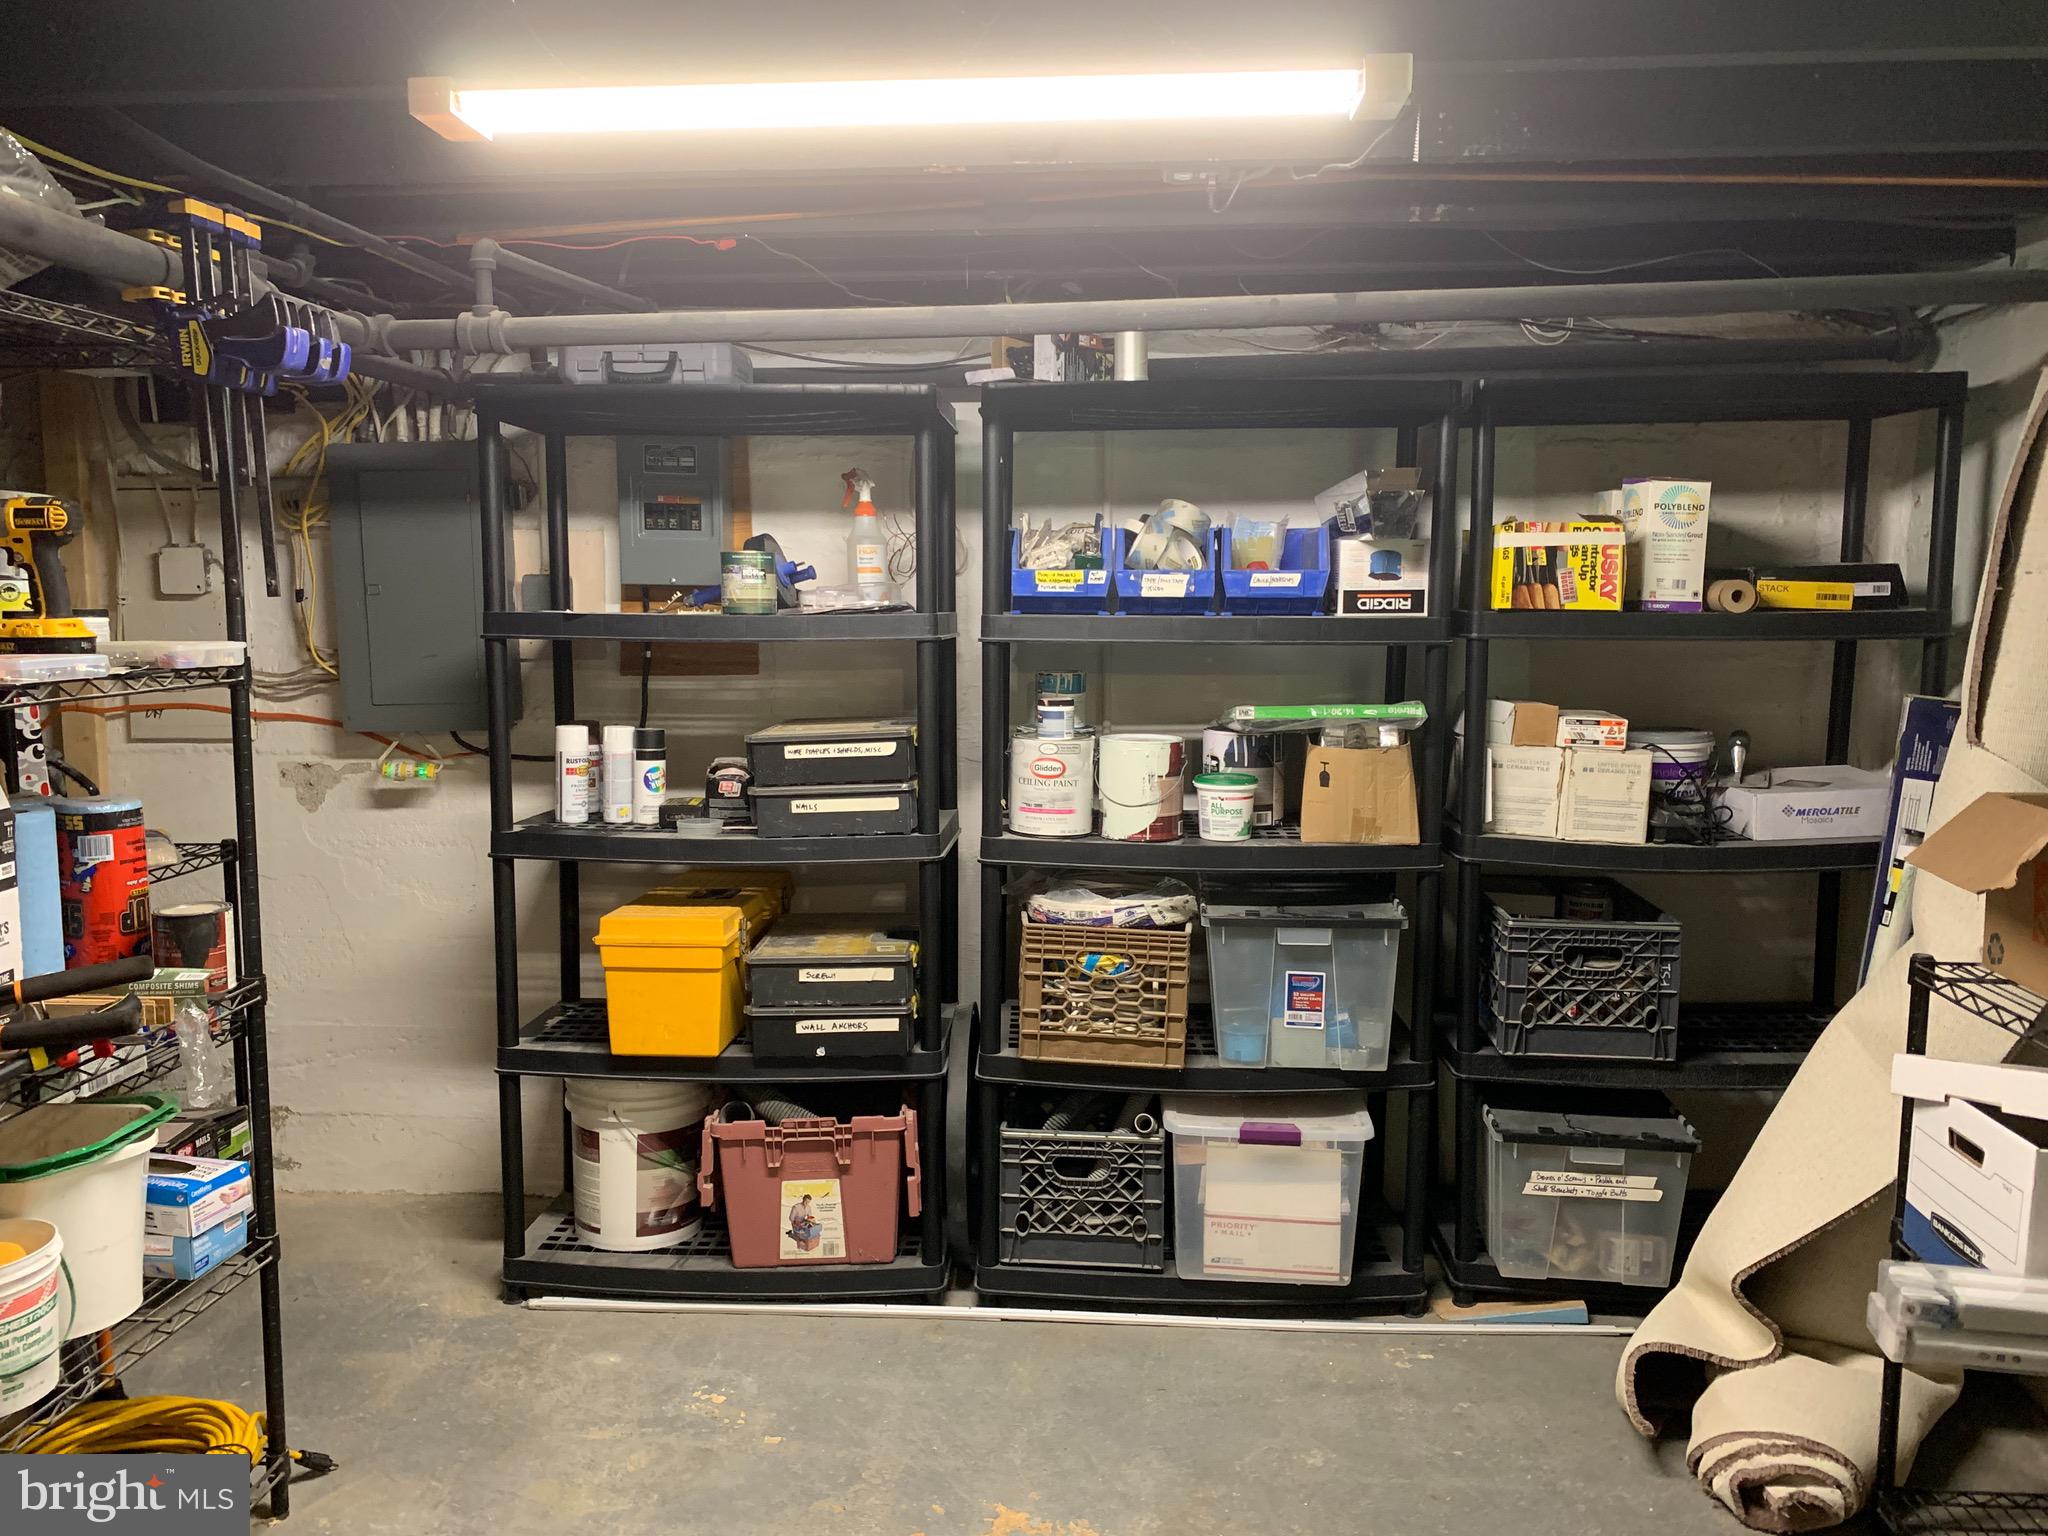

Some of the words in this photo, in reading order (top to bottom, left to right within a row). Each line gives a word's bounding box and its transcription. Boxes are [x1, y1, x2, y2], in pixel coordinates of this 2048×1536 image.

[178, 328, 192, 367] IRWIN
[1654, 502, 1706, 512] POLYBLEND
[1686, 531, 1704, 539] Grout
[1590, 526, 1601, 592] Cntractor
[1758, 584, 1790, 593] STACK
[1357, 597, 1412, 610] RIDGID
[1034, 764, 1062, 772] Glidden
[1018, 777, 1051, 787] CEILING
[1053, 779, 1080, 788] PAINT
[795, 803, 818, 811] NAILS
[1211, 808, 1243, 816] PURPOSE
[1801, 816, 1833, 825] Mosaics
[128, 982, 173, 991] COMPOSITE
[174, 980, 200, 990] SHIMS
[801, 1023, 826, 1031] WALL
[831, 1022, 869, 1031] ANCHORS
[1585, 1189, 1608, 1198] Toggle
[1210, 1221, 1255, 1231] PRIORITY
[1220, 1229, 1244, 1237] MAIL
[1932, 1218, 1965, 1250] BANKERS
[1963, 1244, 1980, 1261] BOX
